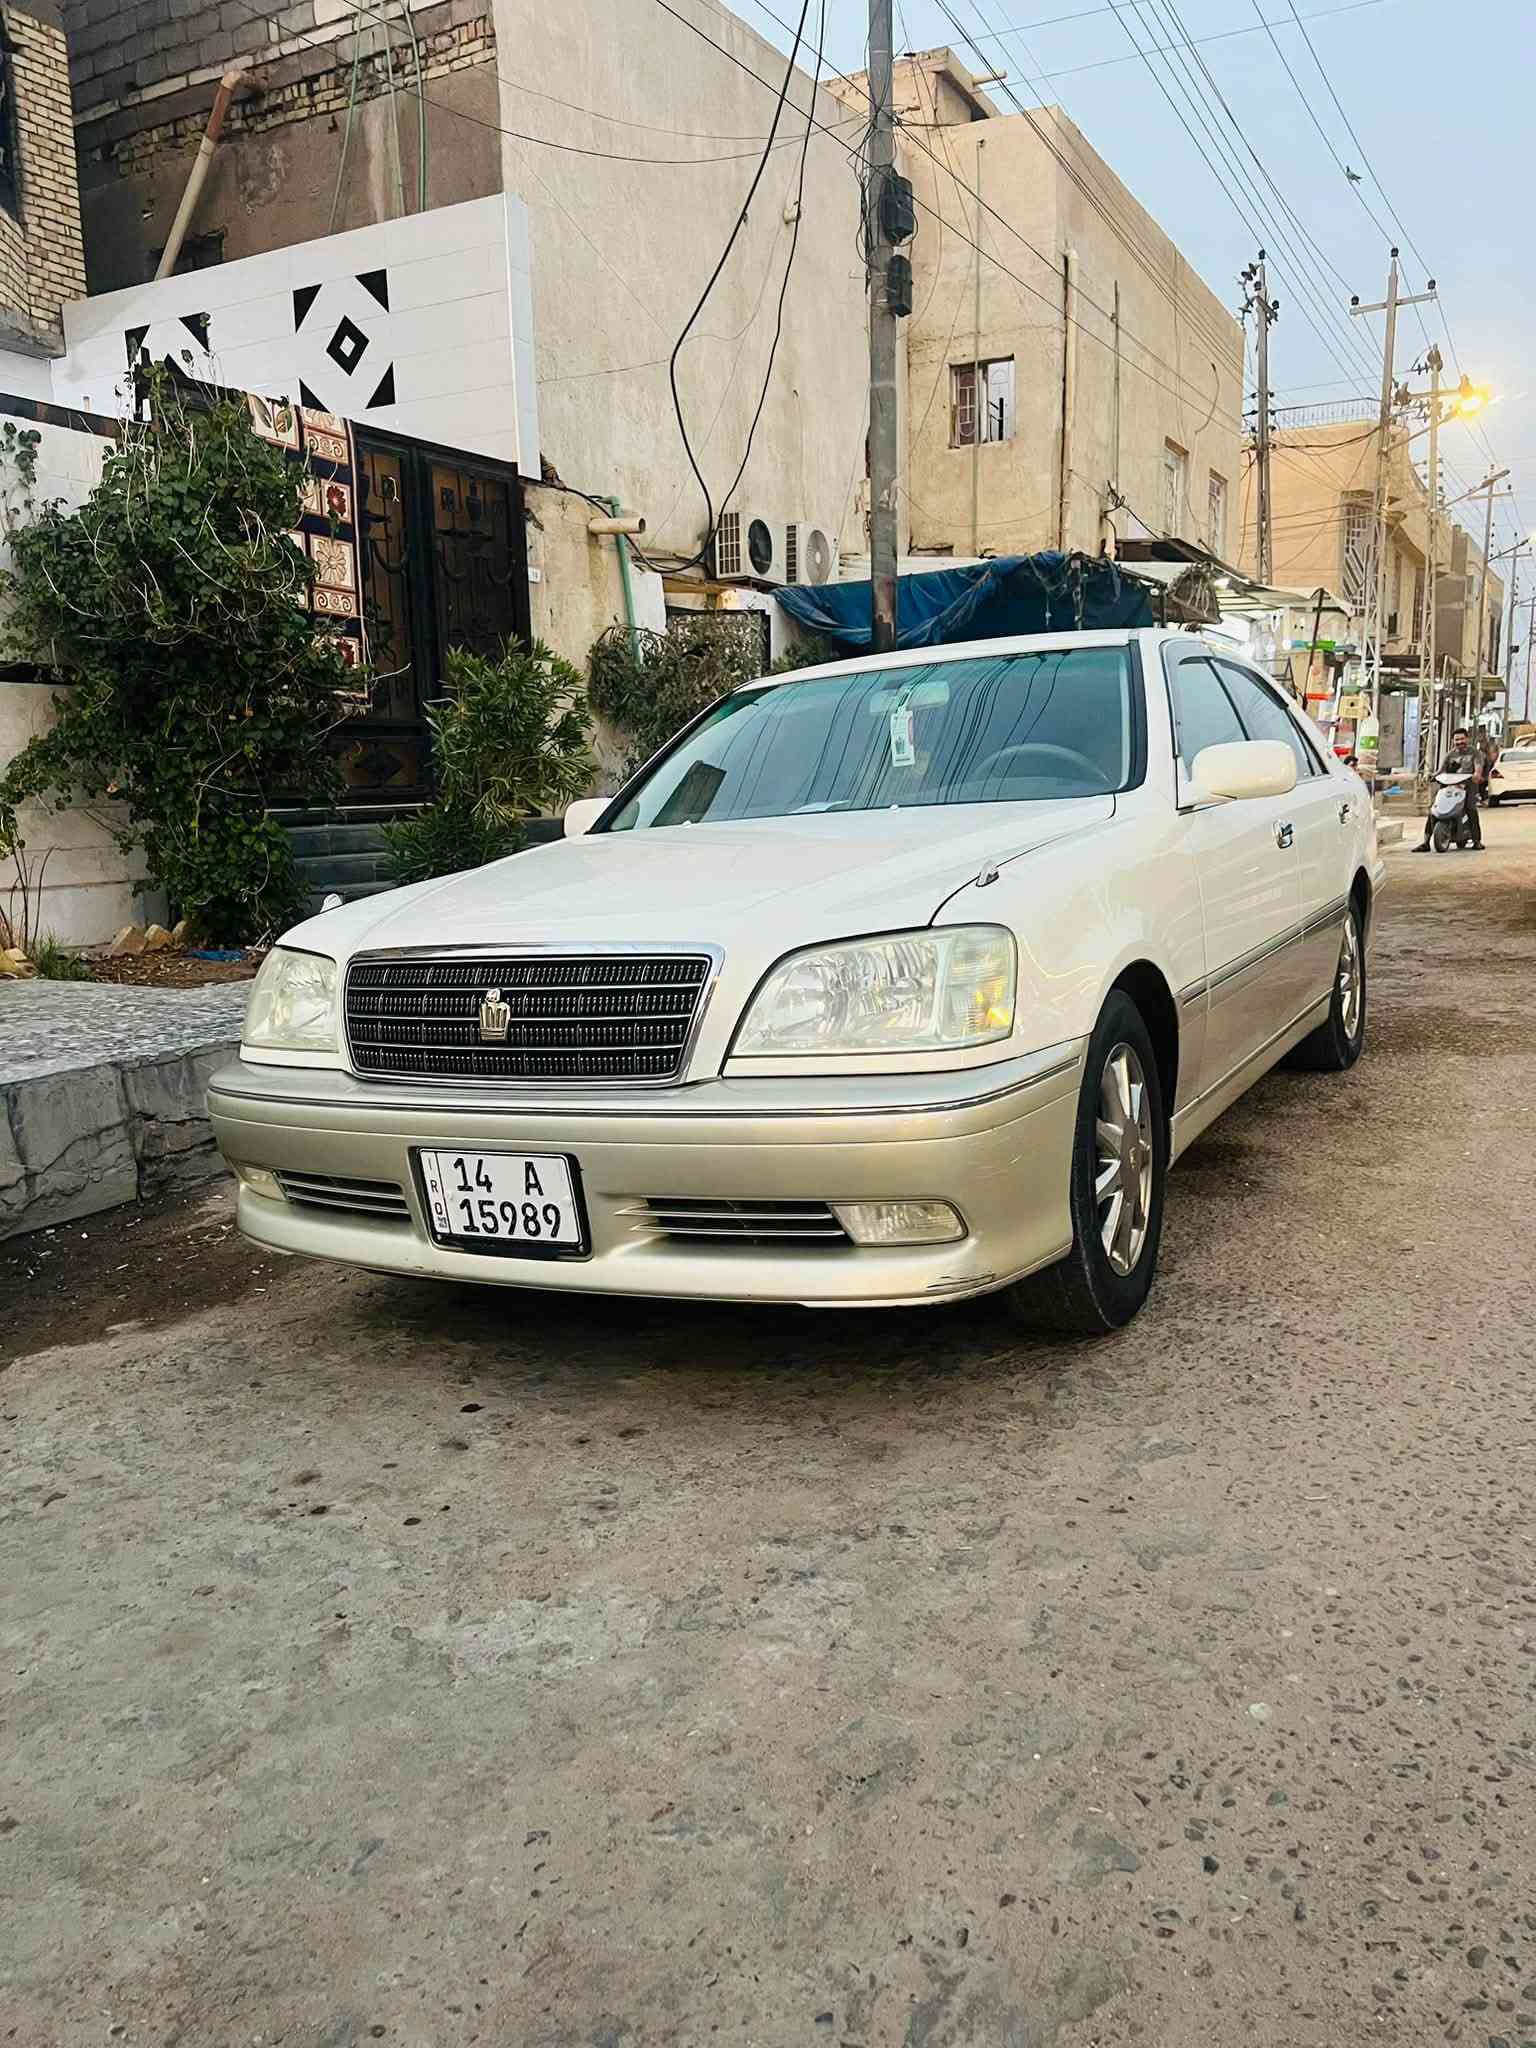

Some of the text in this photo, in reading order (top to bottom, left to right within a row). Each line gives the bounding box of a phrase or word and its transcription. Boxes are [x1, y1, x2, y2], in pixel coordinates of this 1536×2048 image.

[453, 1157, 544, 1196] 14 A
[459, 1198, 561, 1238] 15989
